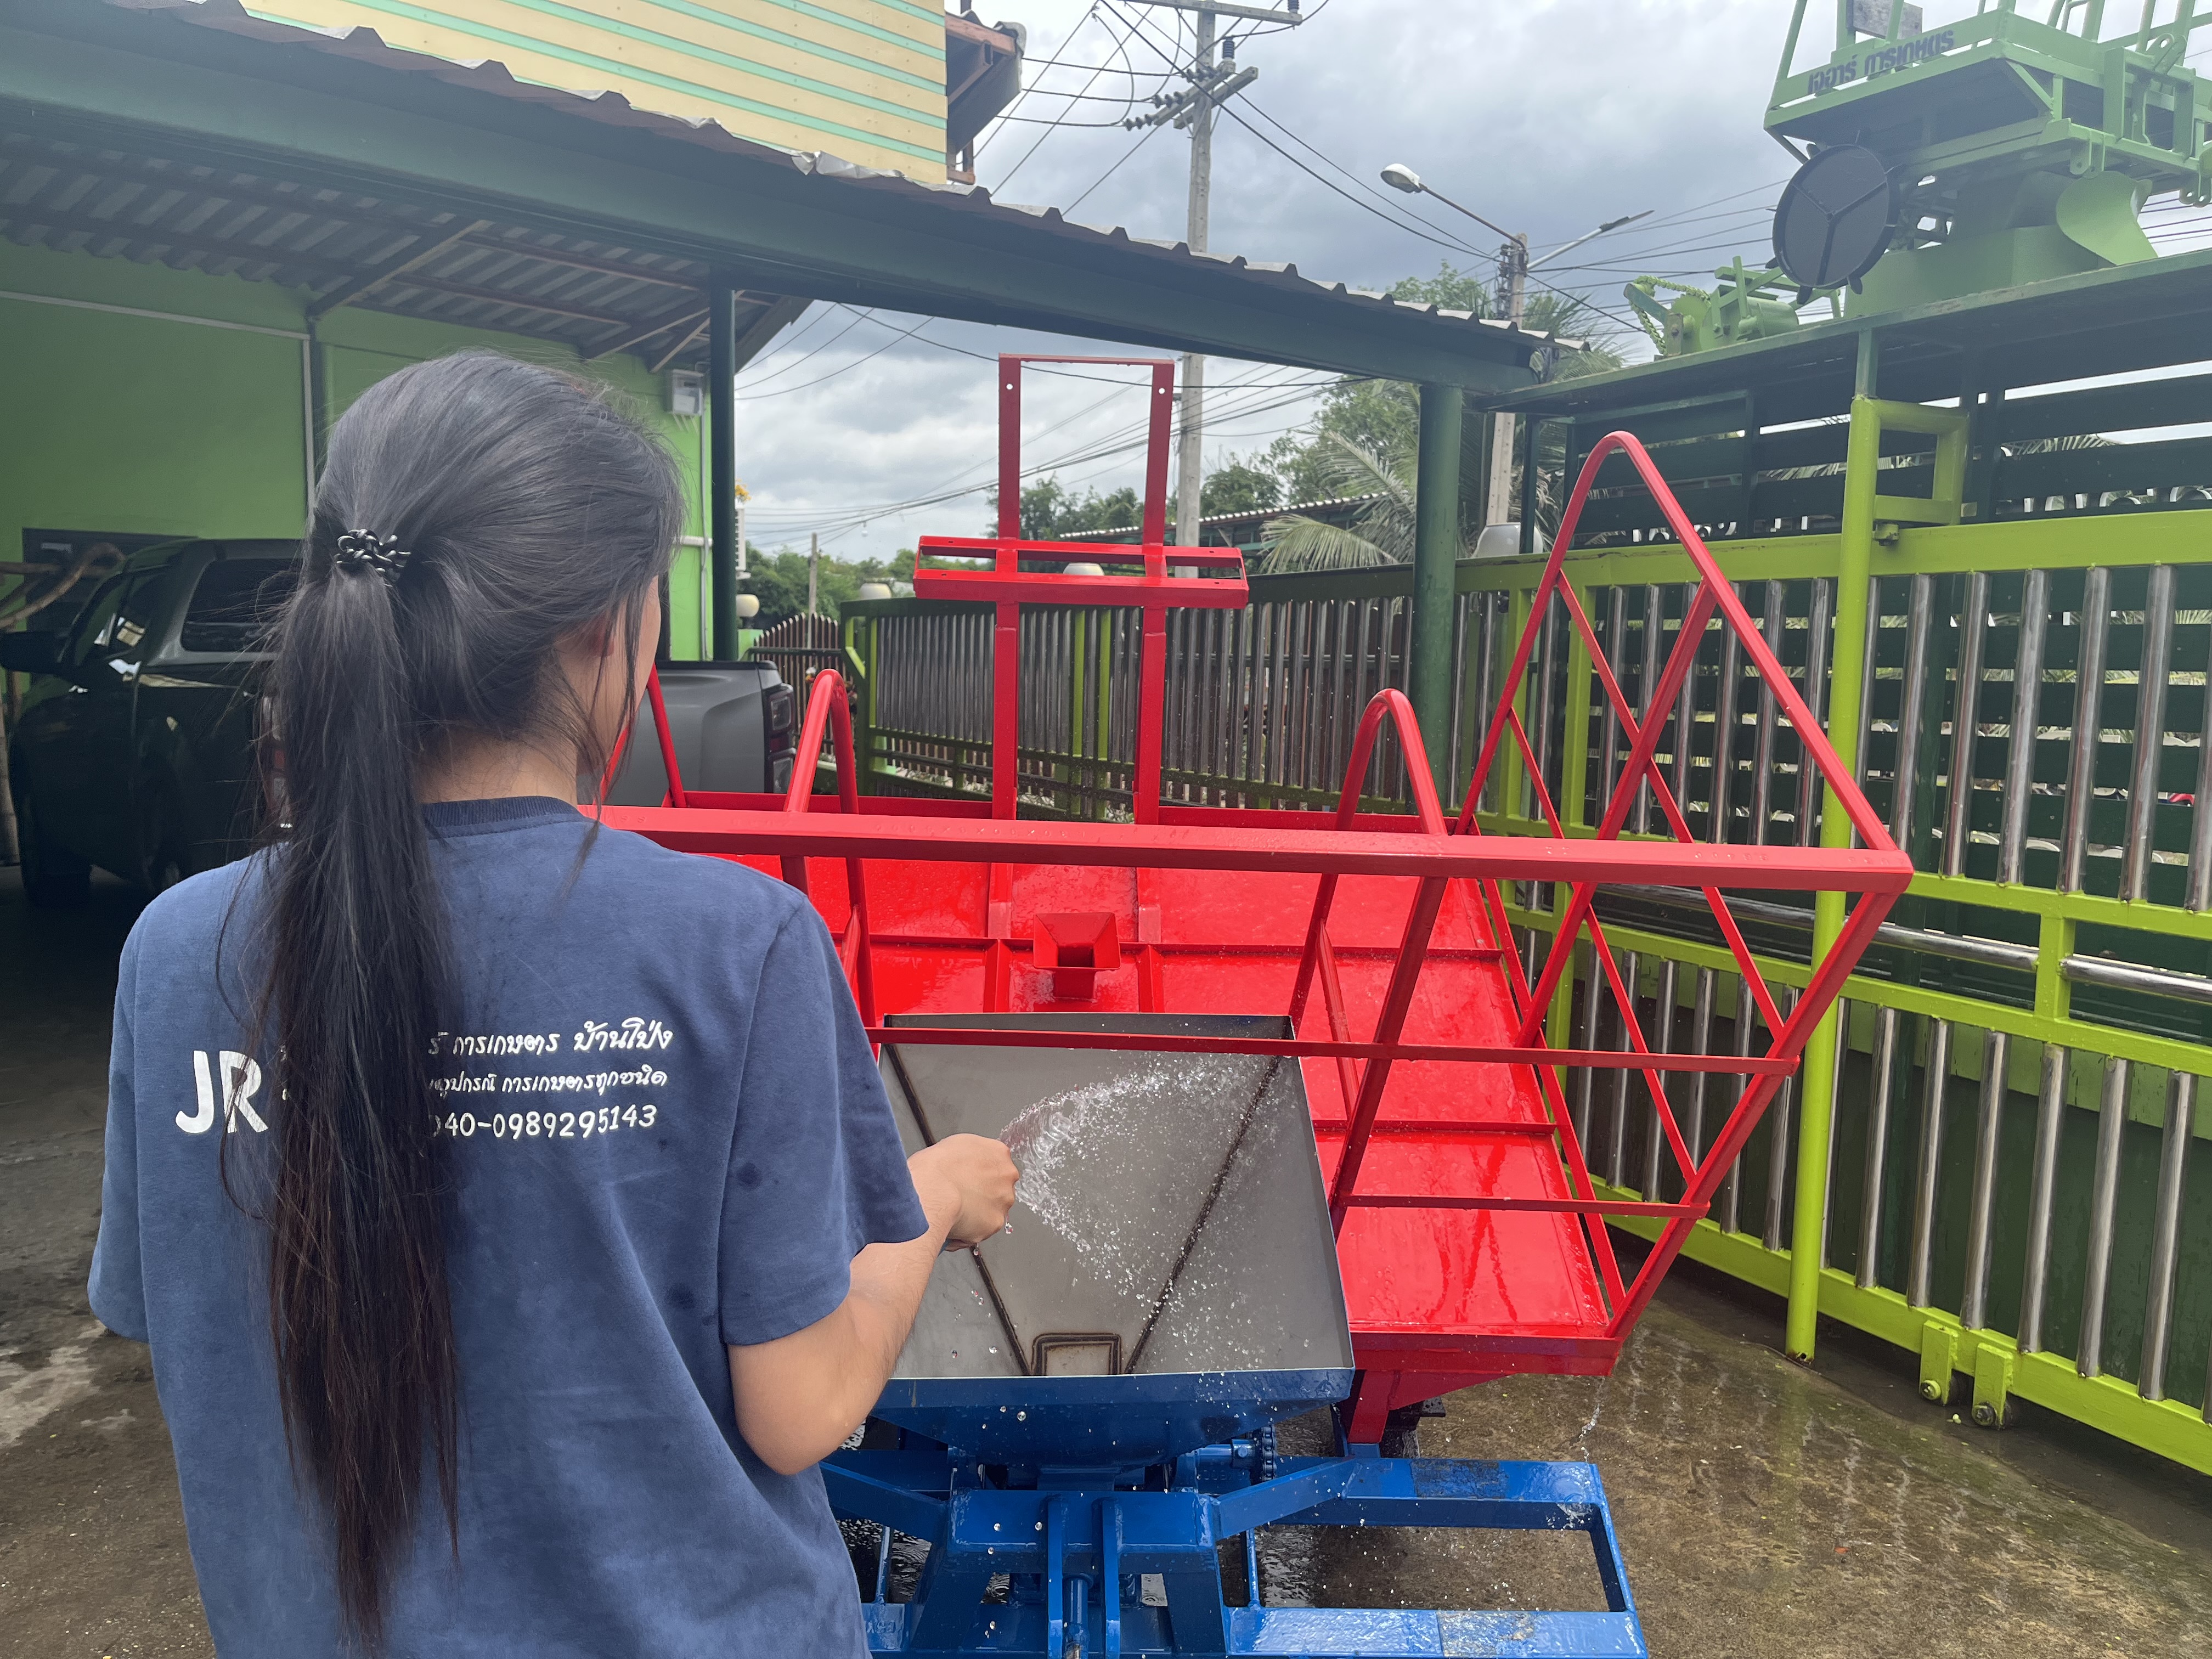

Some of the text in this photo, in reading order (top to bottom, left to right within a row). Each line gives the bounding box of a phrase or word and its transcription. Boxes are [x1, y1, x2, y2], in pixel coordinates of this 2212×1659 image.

[453, 1034, 560, 1056] การเกษตร
[574, 1017, 673, 1050] บ้านโป่ง
[176, 1051, 268, 1133] JR
